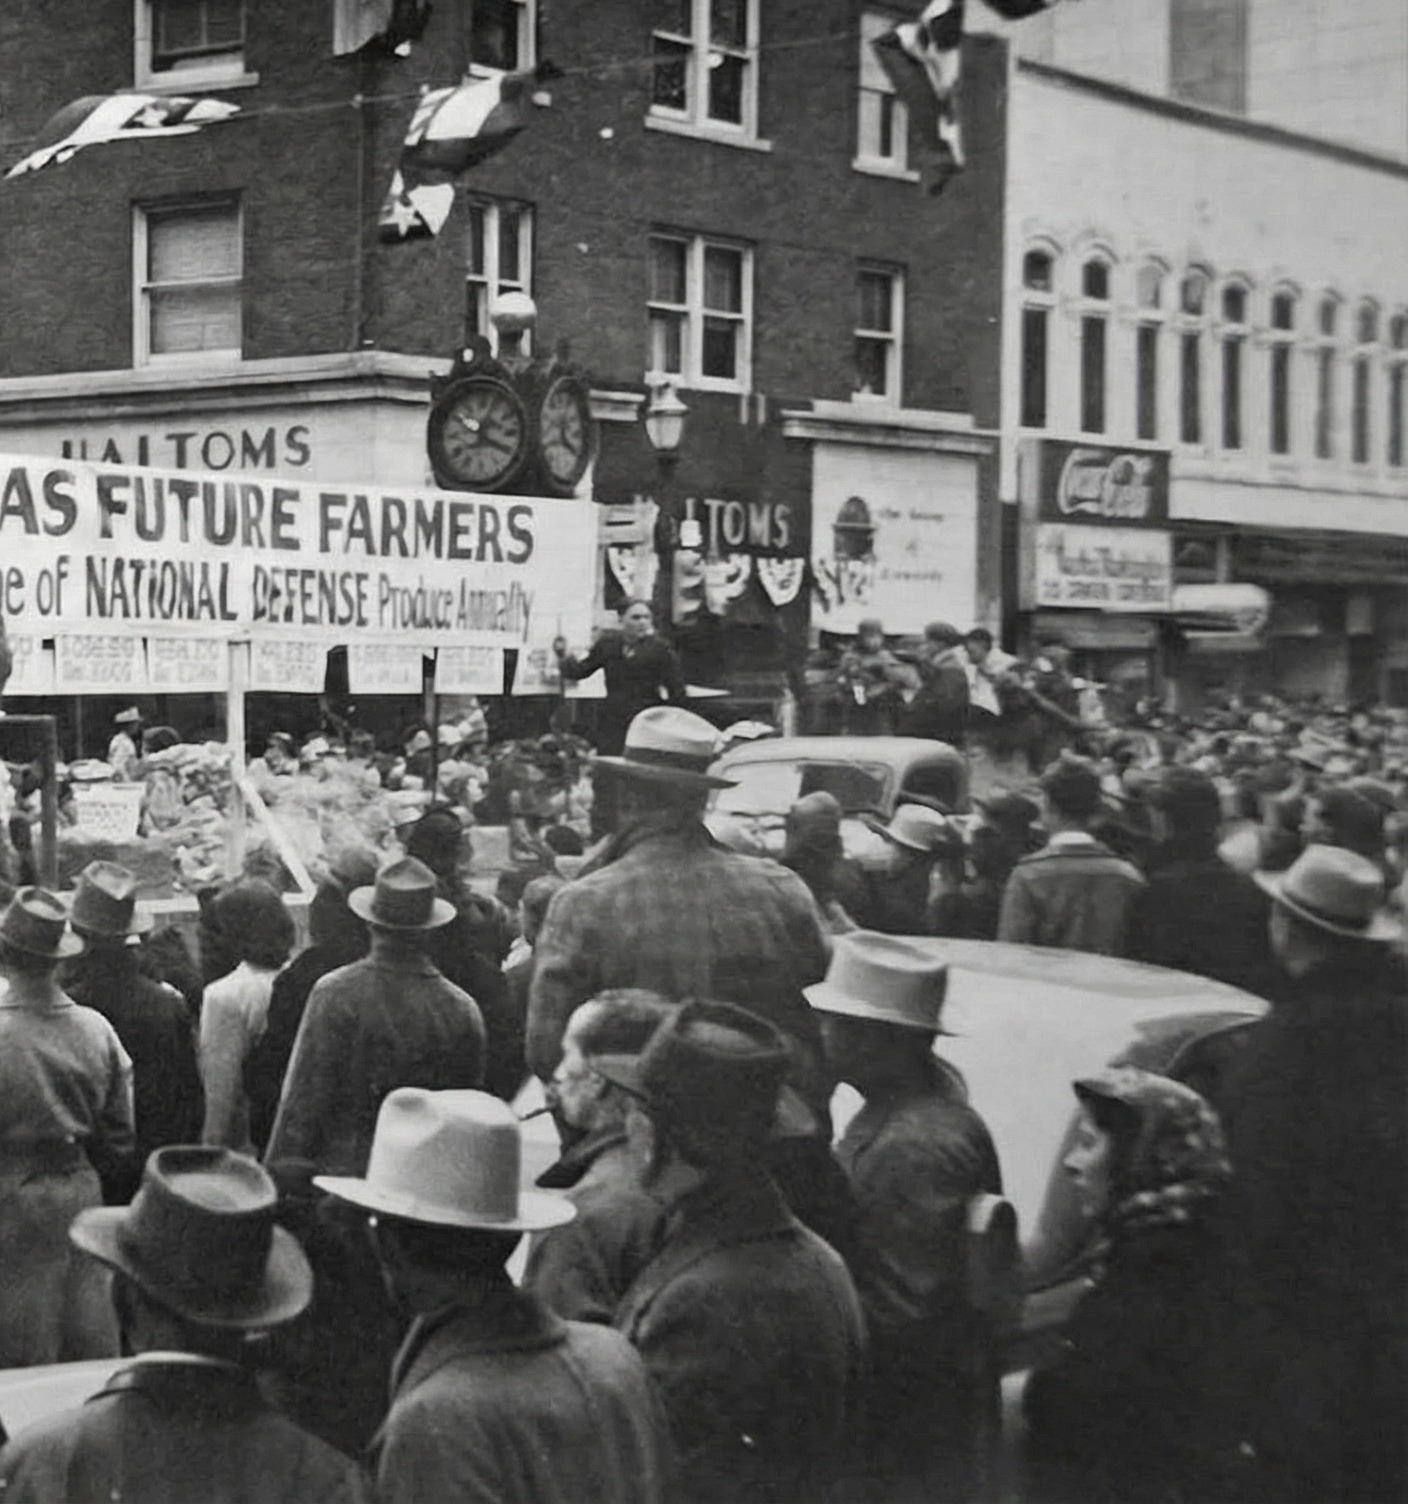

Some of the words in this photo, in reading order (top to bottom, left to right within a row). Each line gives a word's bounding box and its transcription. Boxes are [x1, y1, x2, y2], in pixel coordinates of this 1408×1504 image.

[96, 474, 301, 551] FUTURE
[318, 492, 535, 564] FARMERS
[703, 498, 792, 549] TOMS
[36, 554, 70, 616] of
[85, 555, 238, 621] NATIONAL
[253, 563, 369, 628] DEFENSE
[378, 572, 453, 630] Produce
